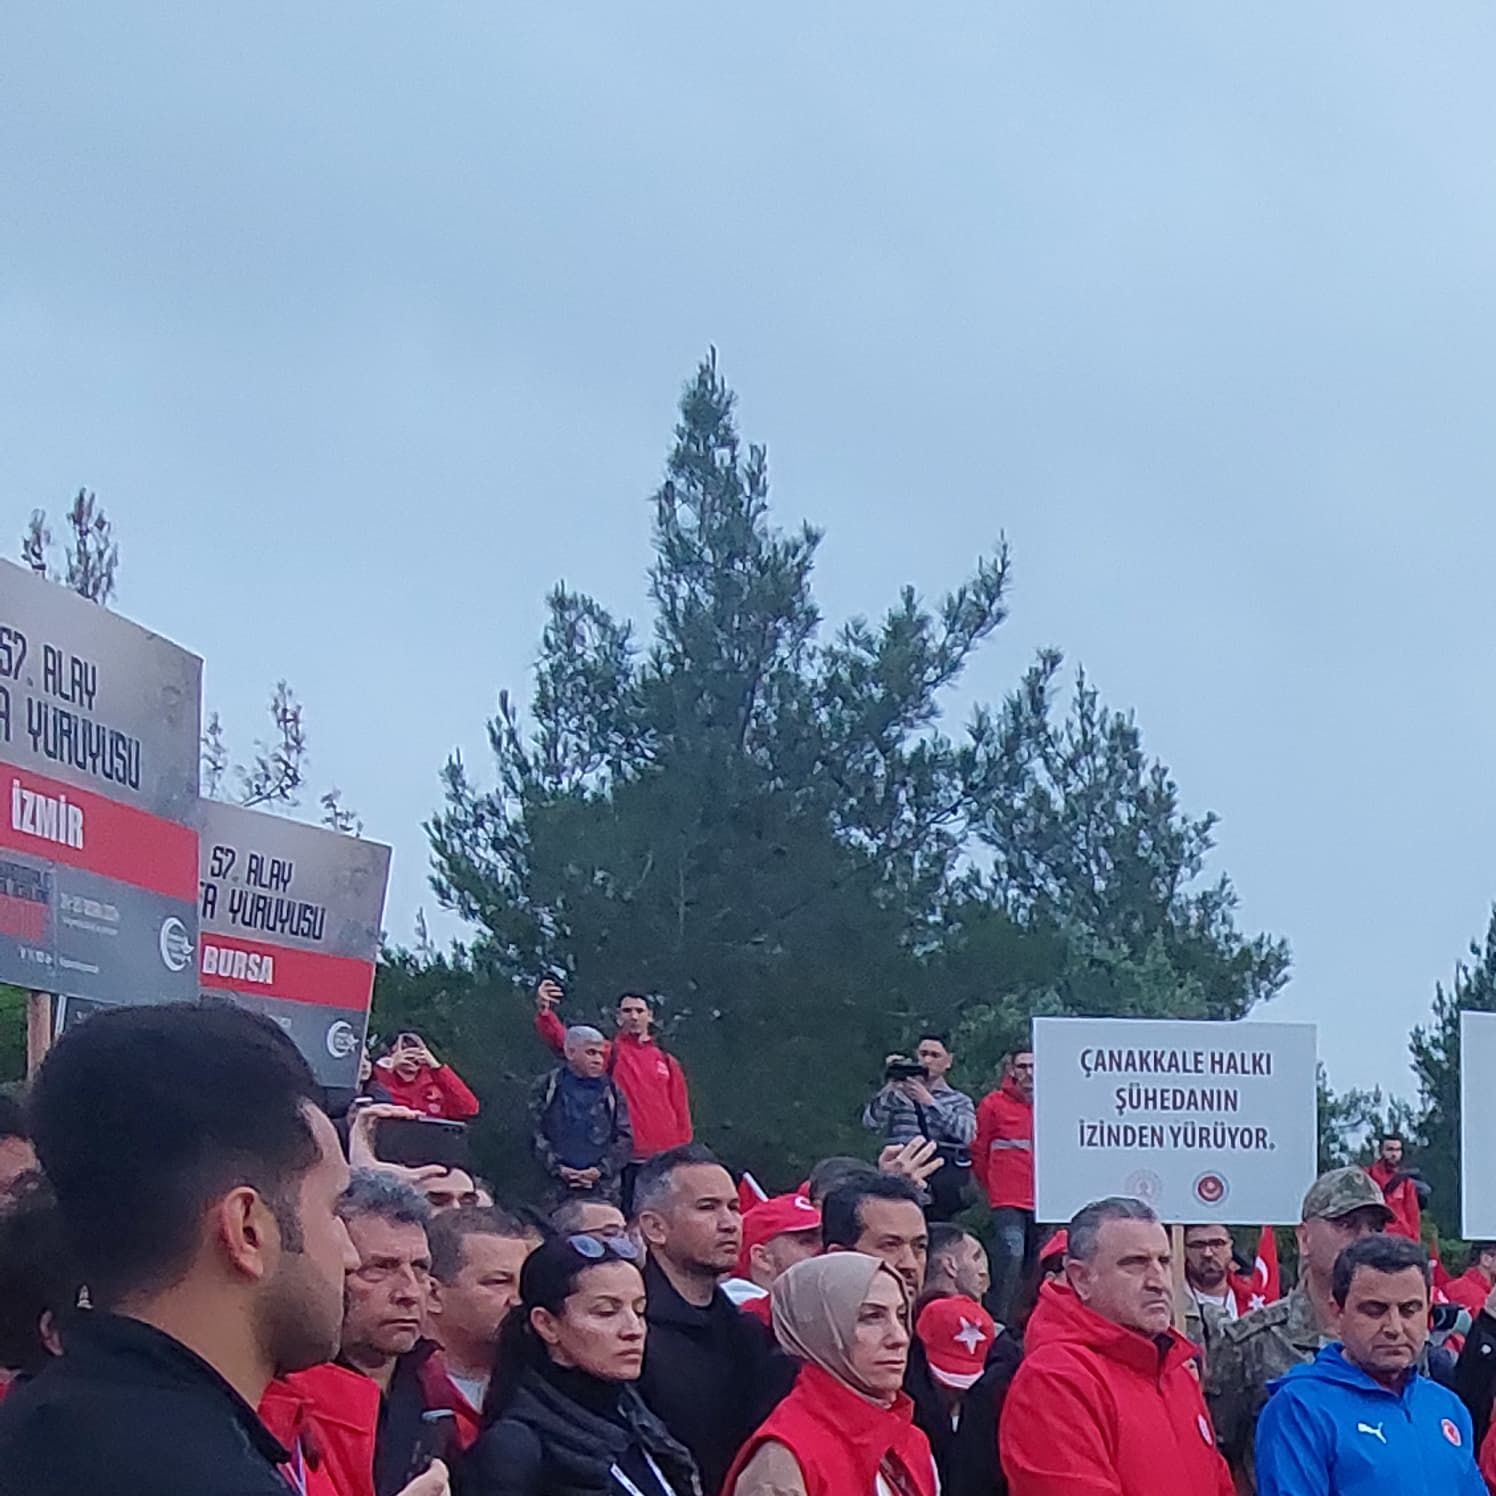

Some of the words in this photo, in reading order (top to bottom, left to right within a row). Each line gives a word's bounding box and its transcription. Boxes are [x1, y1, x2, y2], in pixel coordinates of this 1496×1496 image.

[43, 644, 97, 711] ALAY
[12, 778, 84, 851] İZMİR
[246, 854, 293, 893] ALAY
[202, 945, 274, 985] BURSA
[1080, 1048, 1204, 1079] ÇANAKKALE
[1210, 1051, 1272, 1076] HALKI
[1115, 1082, 1238, 1116] ŞÜHEDANIN
[1079, 1119, 1164, 1148] İZİNDEN
[1168, 1120, 1276, 1151] YÜRÜYOR.
